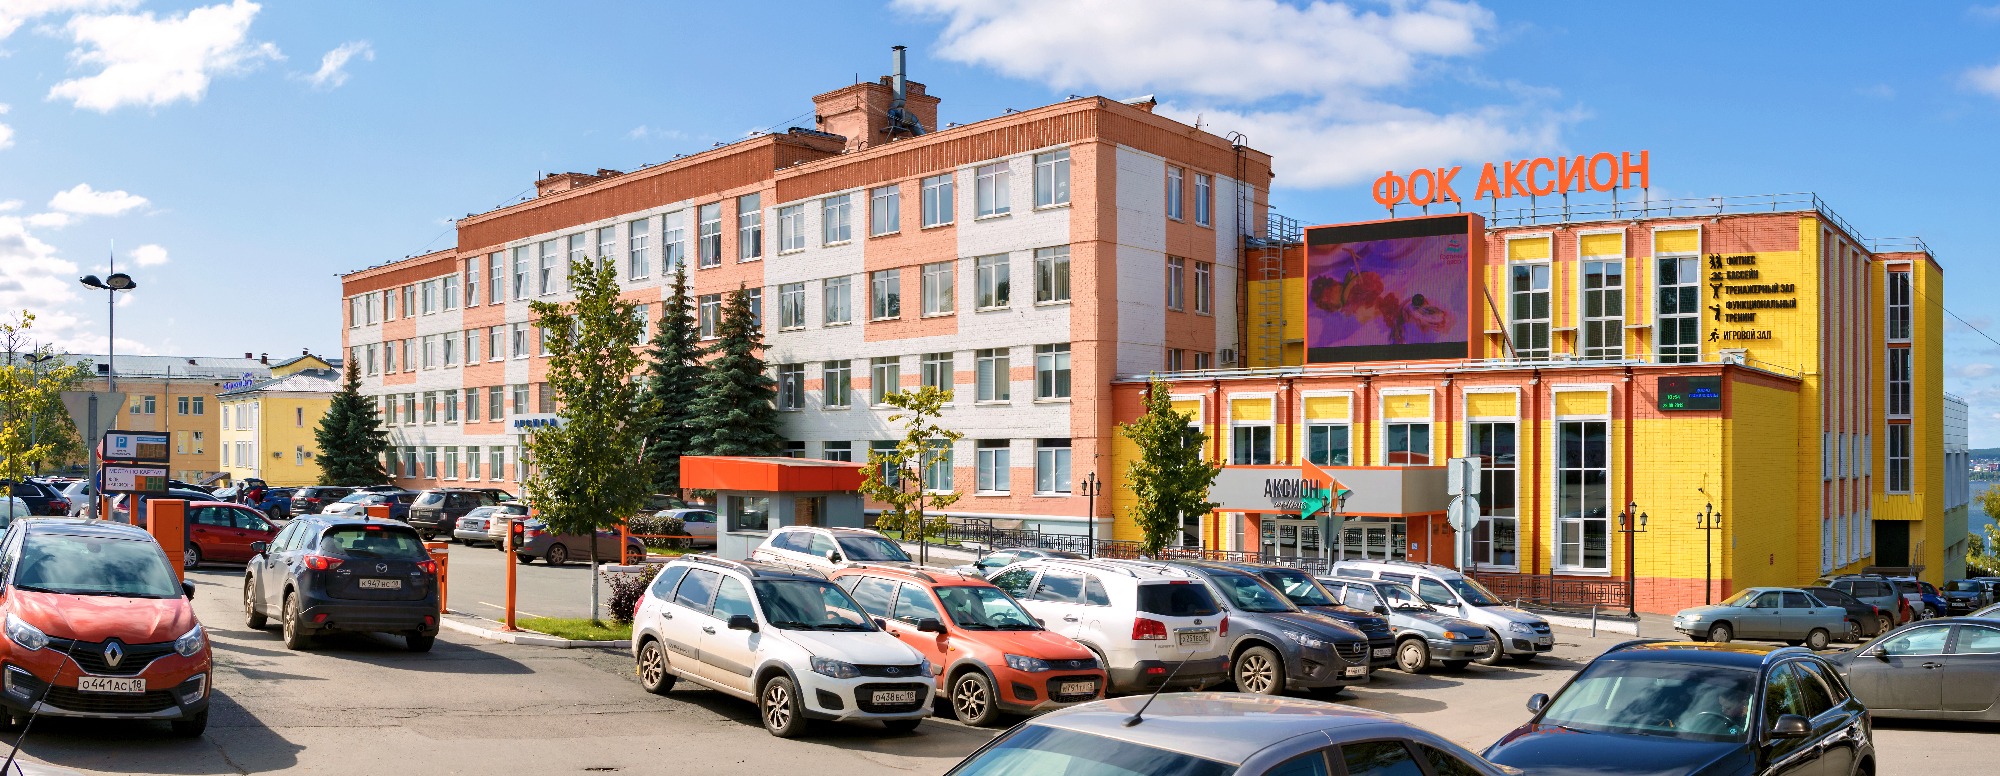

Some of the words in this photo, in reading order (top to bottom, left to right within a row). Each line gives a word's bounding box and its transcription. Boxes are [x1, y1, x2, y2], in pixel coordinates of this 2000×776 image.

[1372, 165, 1462, 209] ФОК
[1474, 150, 1649, 201] АКСИОН
[1726, 255, 1755, 266] ФИТНЕС
[1726, 268, 1759, 280] БАССЕЙН
[1725, 283, 1779, 295] ТРЕНАЖЕРНЫЙ
[1780, 283, 1795, 293] ЗАЛ
[1725, 298, 1796, 310] ФУНКЦИОНАЛЬНЫЙ
[1725, 312, 1756, 322] ТРЕНИНГ
[1723, 328, 1756, 340] ИГРОВОЙ
[1756, 330, 1772, 340] ЗАЛ
[1263, 478, 1320, 498] АКСИОН
